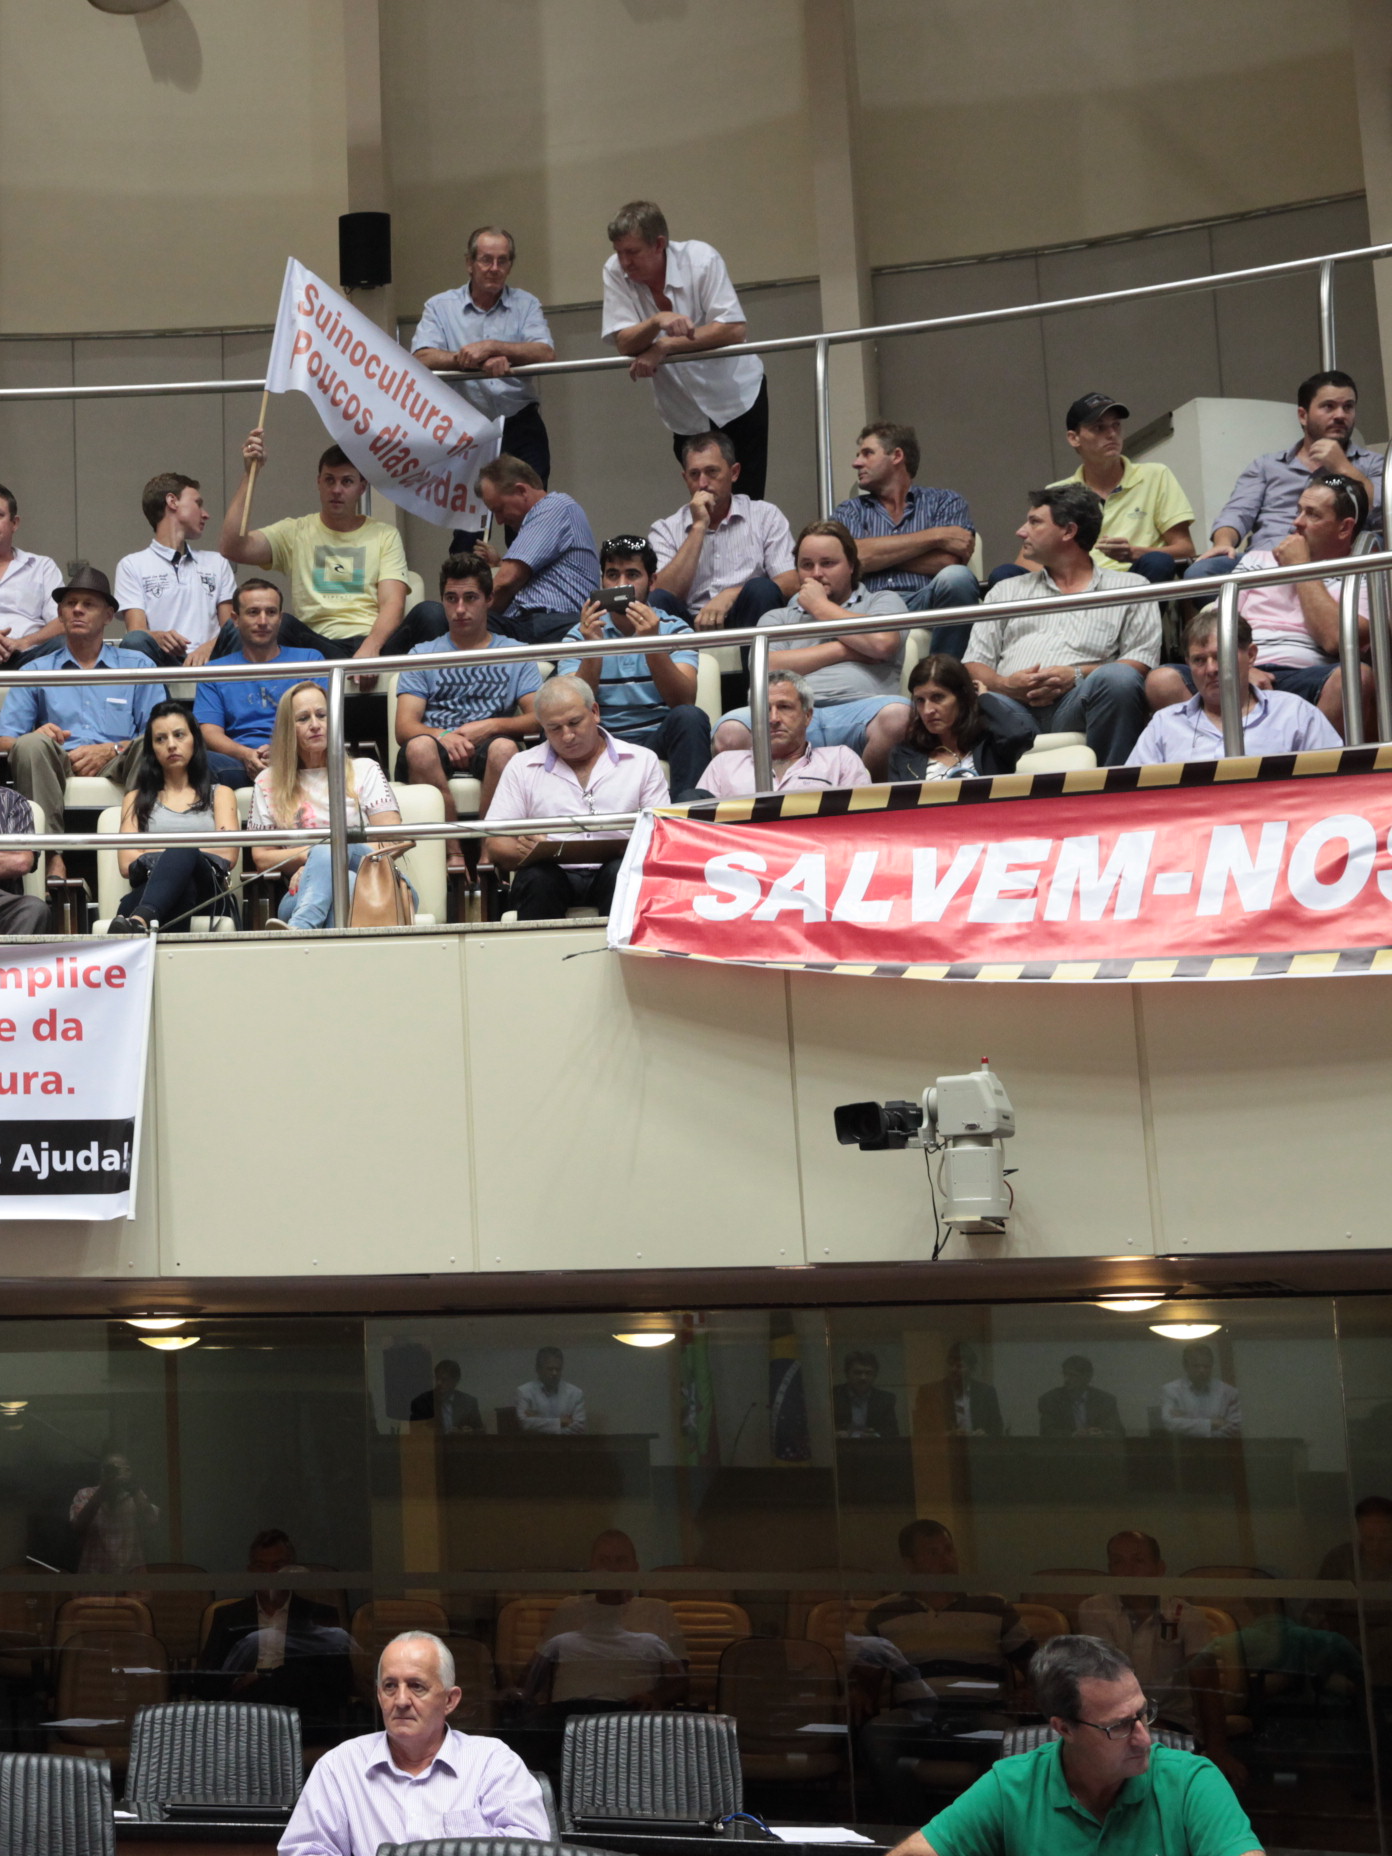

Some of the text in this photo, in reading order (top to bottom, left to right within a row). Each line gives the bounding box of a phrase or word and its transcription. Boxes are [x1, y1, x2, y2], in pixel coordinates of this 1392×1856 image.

[289, 329, 374, 435] Poucos
[368, 424, 419, 478] dias
[297, 283, 454, 444] Suinocultura
[692, 814, 1392, 923] SALVEM-NO
[32, 1009, 84, 1042] da
[12, 1141, 130, 1180] Ajuda!
